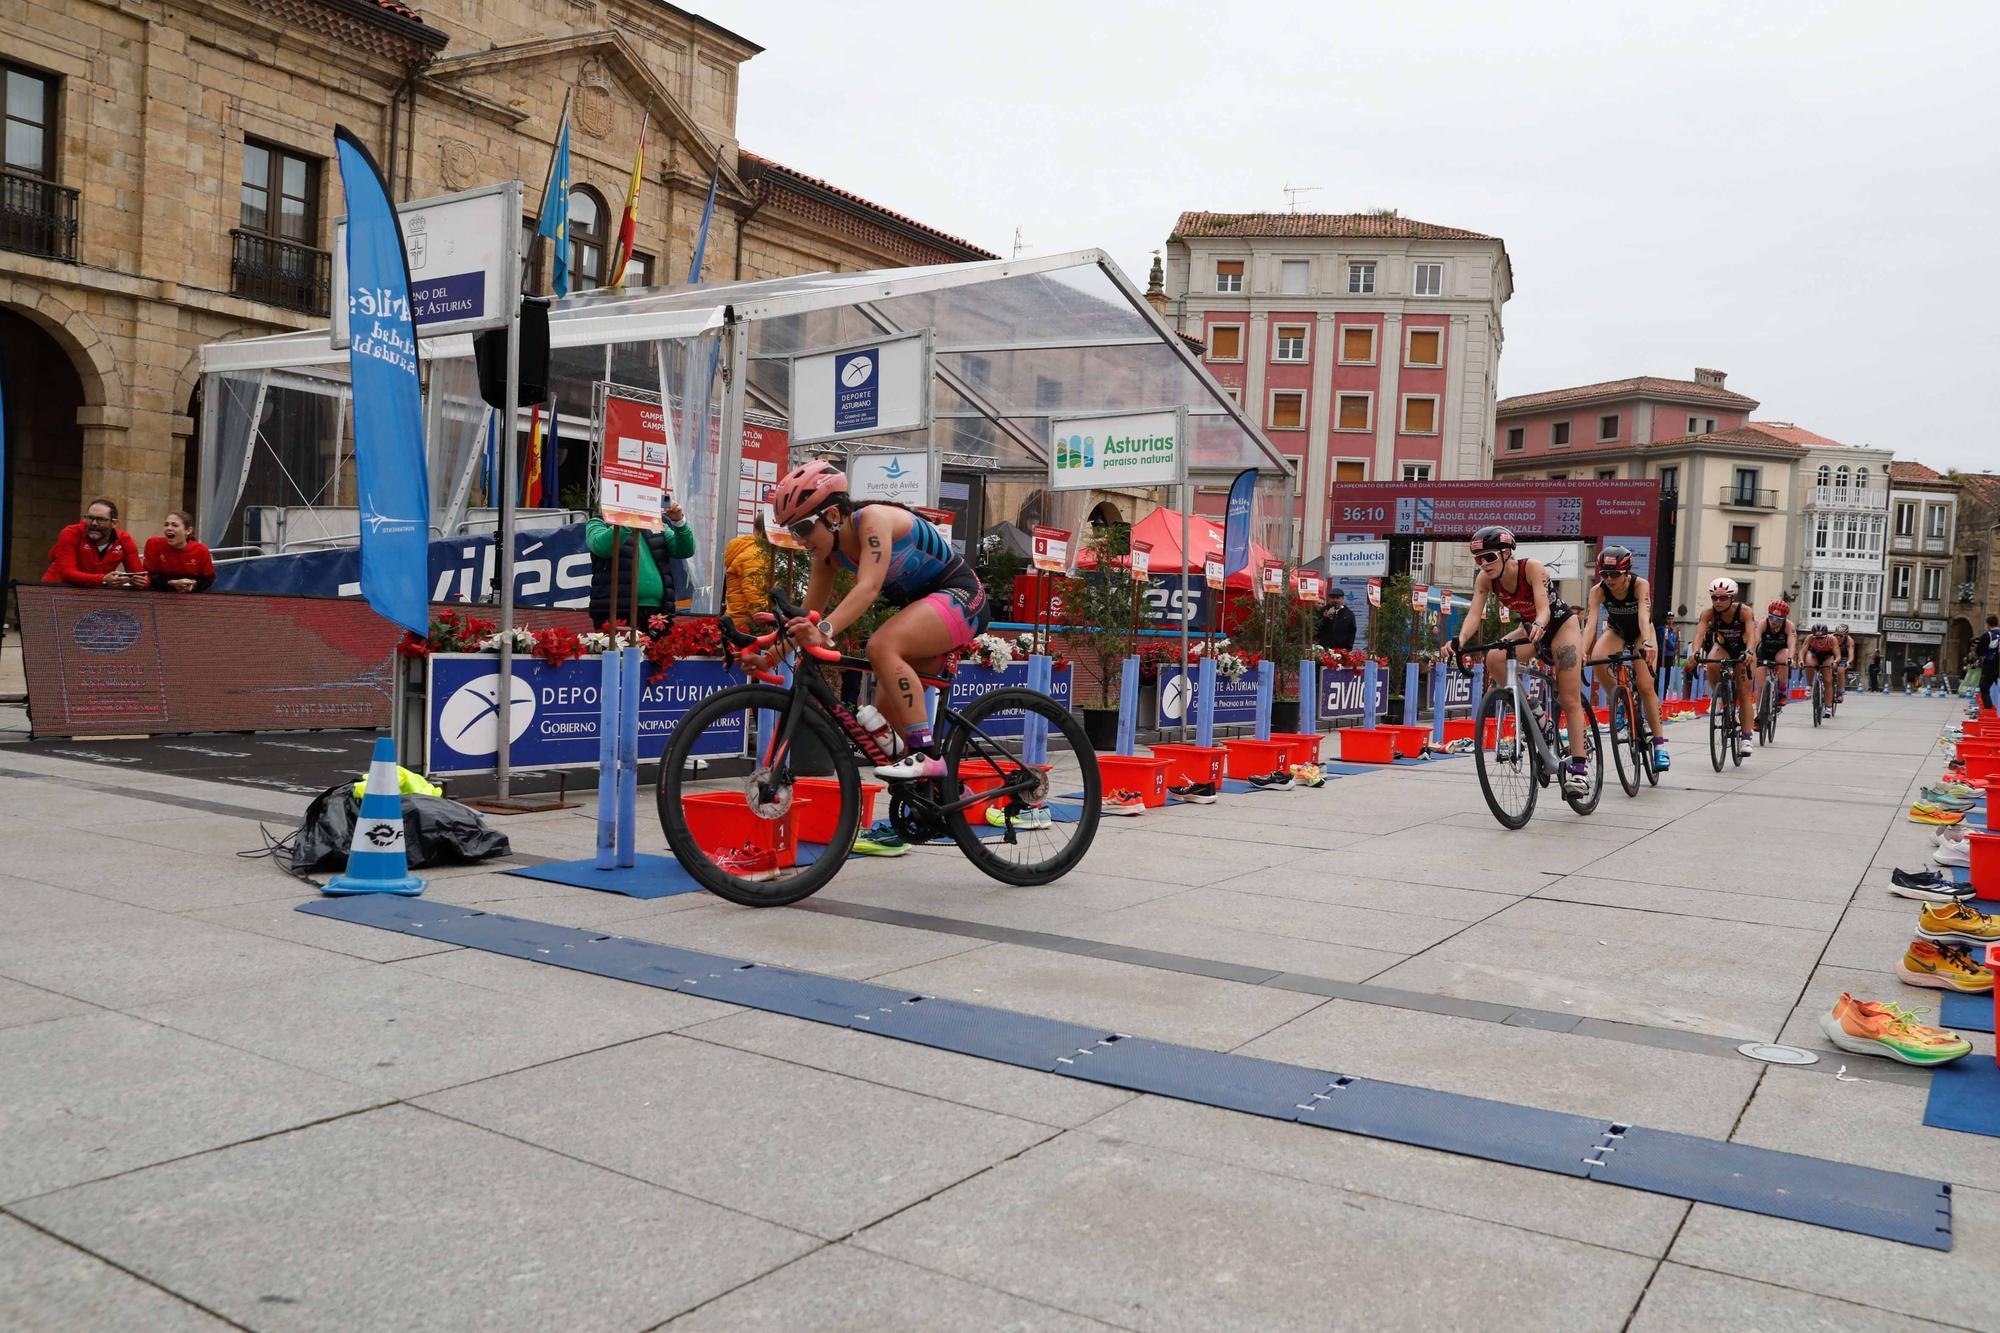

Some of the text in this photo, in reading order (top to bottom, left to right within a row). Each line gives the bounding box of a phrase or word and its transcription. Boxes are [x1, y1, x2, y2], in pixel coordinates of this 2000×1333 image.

[432, 288, 448, 299] DEL
[427, 299, 472, 315] ASTURIAS
[841, 391, 871, 402] DEPORTE
[841, 400, 872, 410] ASTURIANO
[742, 429, 763, 440] ATLÓN
[1103, 434, 1174, 454] Asturias
[1140, 453, 1174, 465] natural
[867, 482, 889, 490] Puerto
[899, 481, 920, 489] Avilés
[614, 484, 620, 502] 1
[1434, 500, 1456, 508] SARA
[1458, 500, 1502, 508] GUERRERO
[1503, 500, 1536, 508] MANSO
[1557, 498, 1581, 508] 32:25
[1343, 507, 1385, 521] 36:10
[1401, 512, 1581, 522] 19 RAQUEL ALZAGA CRIADO +2:24
[1400, 524, 1410, 532] 20
[1434, 524, 1464, 532] ESTHER
[1556, 524, 1580, 534] +2:25
[867, 535, 881, 548] 6
[1038, 542, 1044, 552] 9
[871, 551, 882, 564] 7
[1885, 619, 1922, 630] SEIKO
[898, 677, 910, 691] 6
[542, 686, 603, 705] DEPO
[1327, 675, 1383, 710] avils
[902, 693, 914, 708] 7
[540, 720, 596, 735] GOBIERNO
[1279, 754, 1286, 763] 17
[1212, 762, 1219, 771] 15
[779, 824, 785, 838] 1
